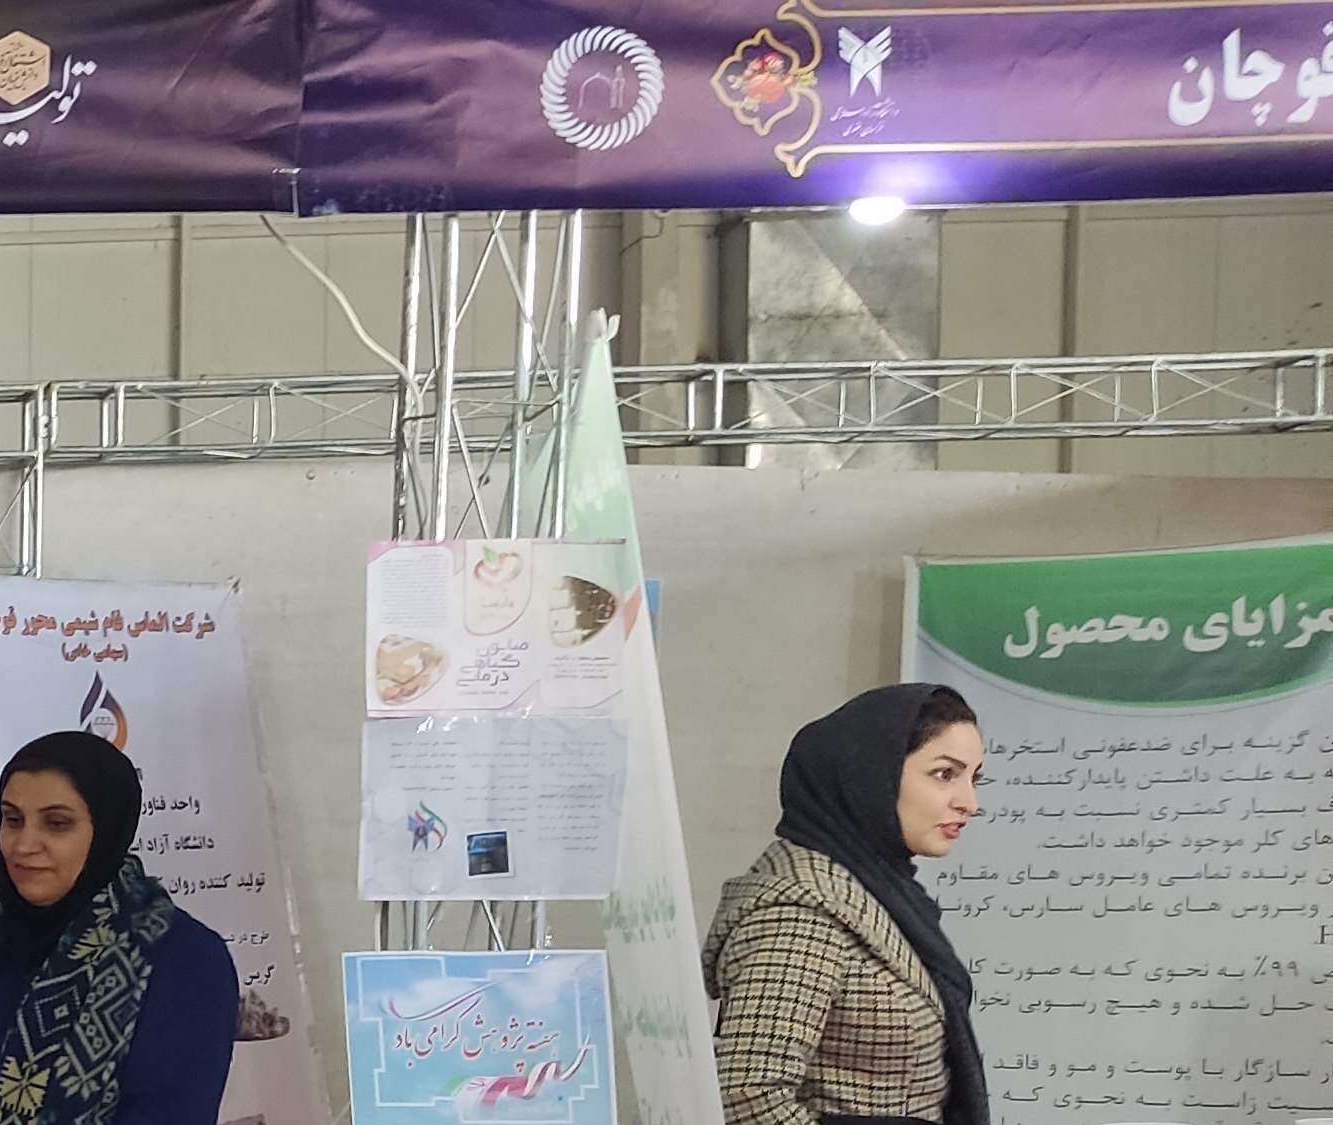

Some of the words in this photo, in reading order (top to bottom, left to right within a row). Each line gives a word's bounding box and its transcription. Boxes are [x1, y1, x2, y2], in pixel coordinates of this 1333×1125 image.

[1004, 606, 1170, 659] محصول
[1073, 737, 1171, 761] ضدعفونی
[1181, 734, 1234, 758] برای
[1244, 730, 1310, 754] گزینه
[1136, 766, 1210, 791] داشتن
[1220, 764, 1274, 782] علت
[171, 796, 200, 815] واحد
[1073, 802, 1140, 818] نسبت
[1149, 798, 1230, 822] کمتری
[1239, 798, 1307, 821] بسیار
[147, 833, 170, 852] آزاد
[175, 836, 214, 851] دانشگاه
[1113, 830, 1171, 854] خواهد
[1181, 831, 1243, 853] موجود
[1253, 830, 1286, 855] کلر
[199, 873, 231, 891] کننده
[237, 872, 266, 892] تولید
[936, 864, 999, 884] مقاوم
[1007, 865, 1059, 886] های
[1069, 870, 1149, 887] ویروس
[1158, 863, 1230, 888] تمامی
[169, 877, 195, 895] روان
[1091, 896, 1155, 919] عامل
[1163, 896, 1221, 918] های
[1231, 899, 1318, 919] ویروس
[243, 964, 275, 986] گریس
[994, 960, 1061, 981] صورت
[1104, 958, 1139, 977] که
[1144, 963, 1209, 983] نحوی
[1106, 997, 1162, 1016] هیچ
[1190, 1000, 1251, 1013] شده
[1259, 995, 1314, 1017] حل
[394, 1027, 412, 1067] باد
[992, 1053, 1040, 1072] فاقد
[1124, 1060, 1191, 1081] پوست
[1233, 1058, 1312, 1083] سازگار
[1053, 1089, 1127, 1109] نحوی
